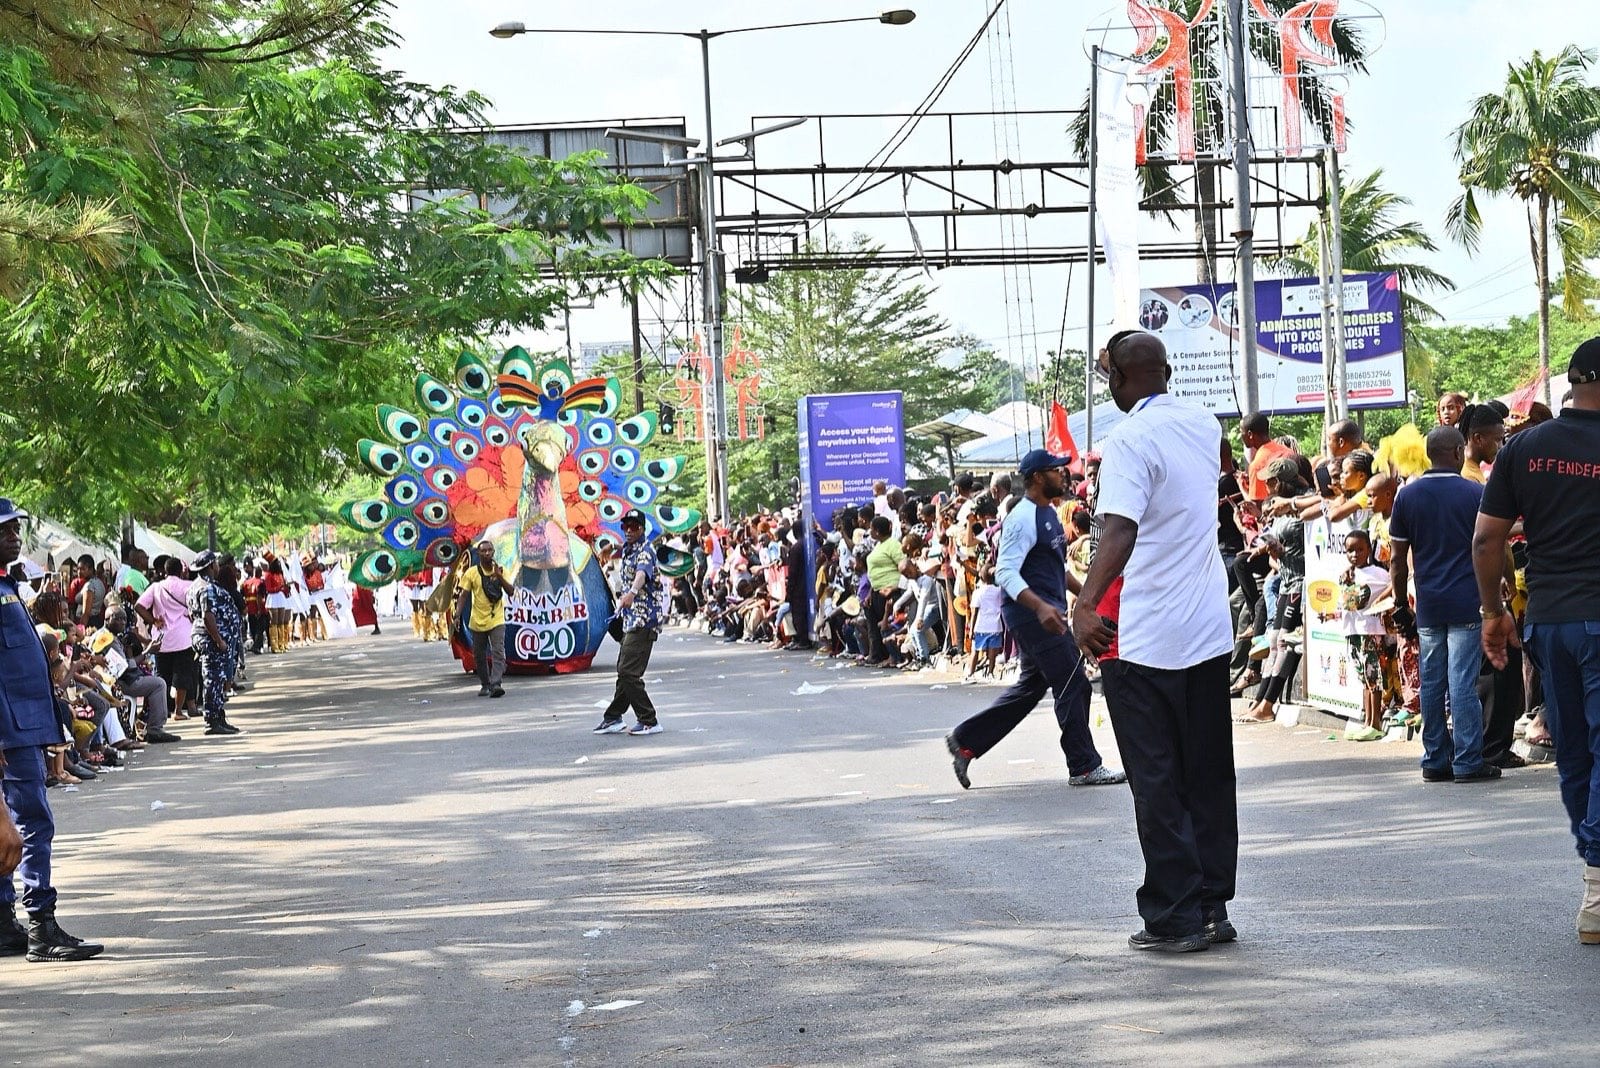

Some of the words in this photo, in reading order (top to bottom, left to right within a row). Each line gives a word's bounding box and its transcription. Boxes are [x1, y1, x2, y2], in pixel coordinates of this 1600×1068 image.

[1260, 318, 1321, 332] ADMISSION
[1343, 311, 1394, 326] ROGRESS
[1274, 332, 1298, 343] INTO
[1301, 325, 1380, 342] POSDUATE
[1291, 338, 1365, 354] PROGMES
[1180, 351, 1211, 360] Computer
[1175, 376, 1213, 385] Criminology
[1182, 389, 1207, 397] Nursing
[851, 428, 869, 436] your
[870, 426, 893, 434] funds
[817, 437, 857, 448] anywhere
[858, 437, 865, 445] in
[867, 435, 896, 445] Nigeria
[517, 627, 574, 657] @20
